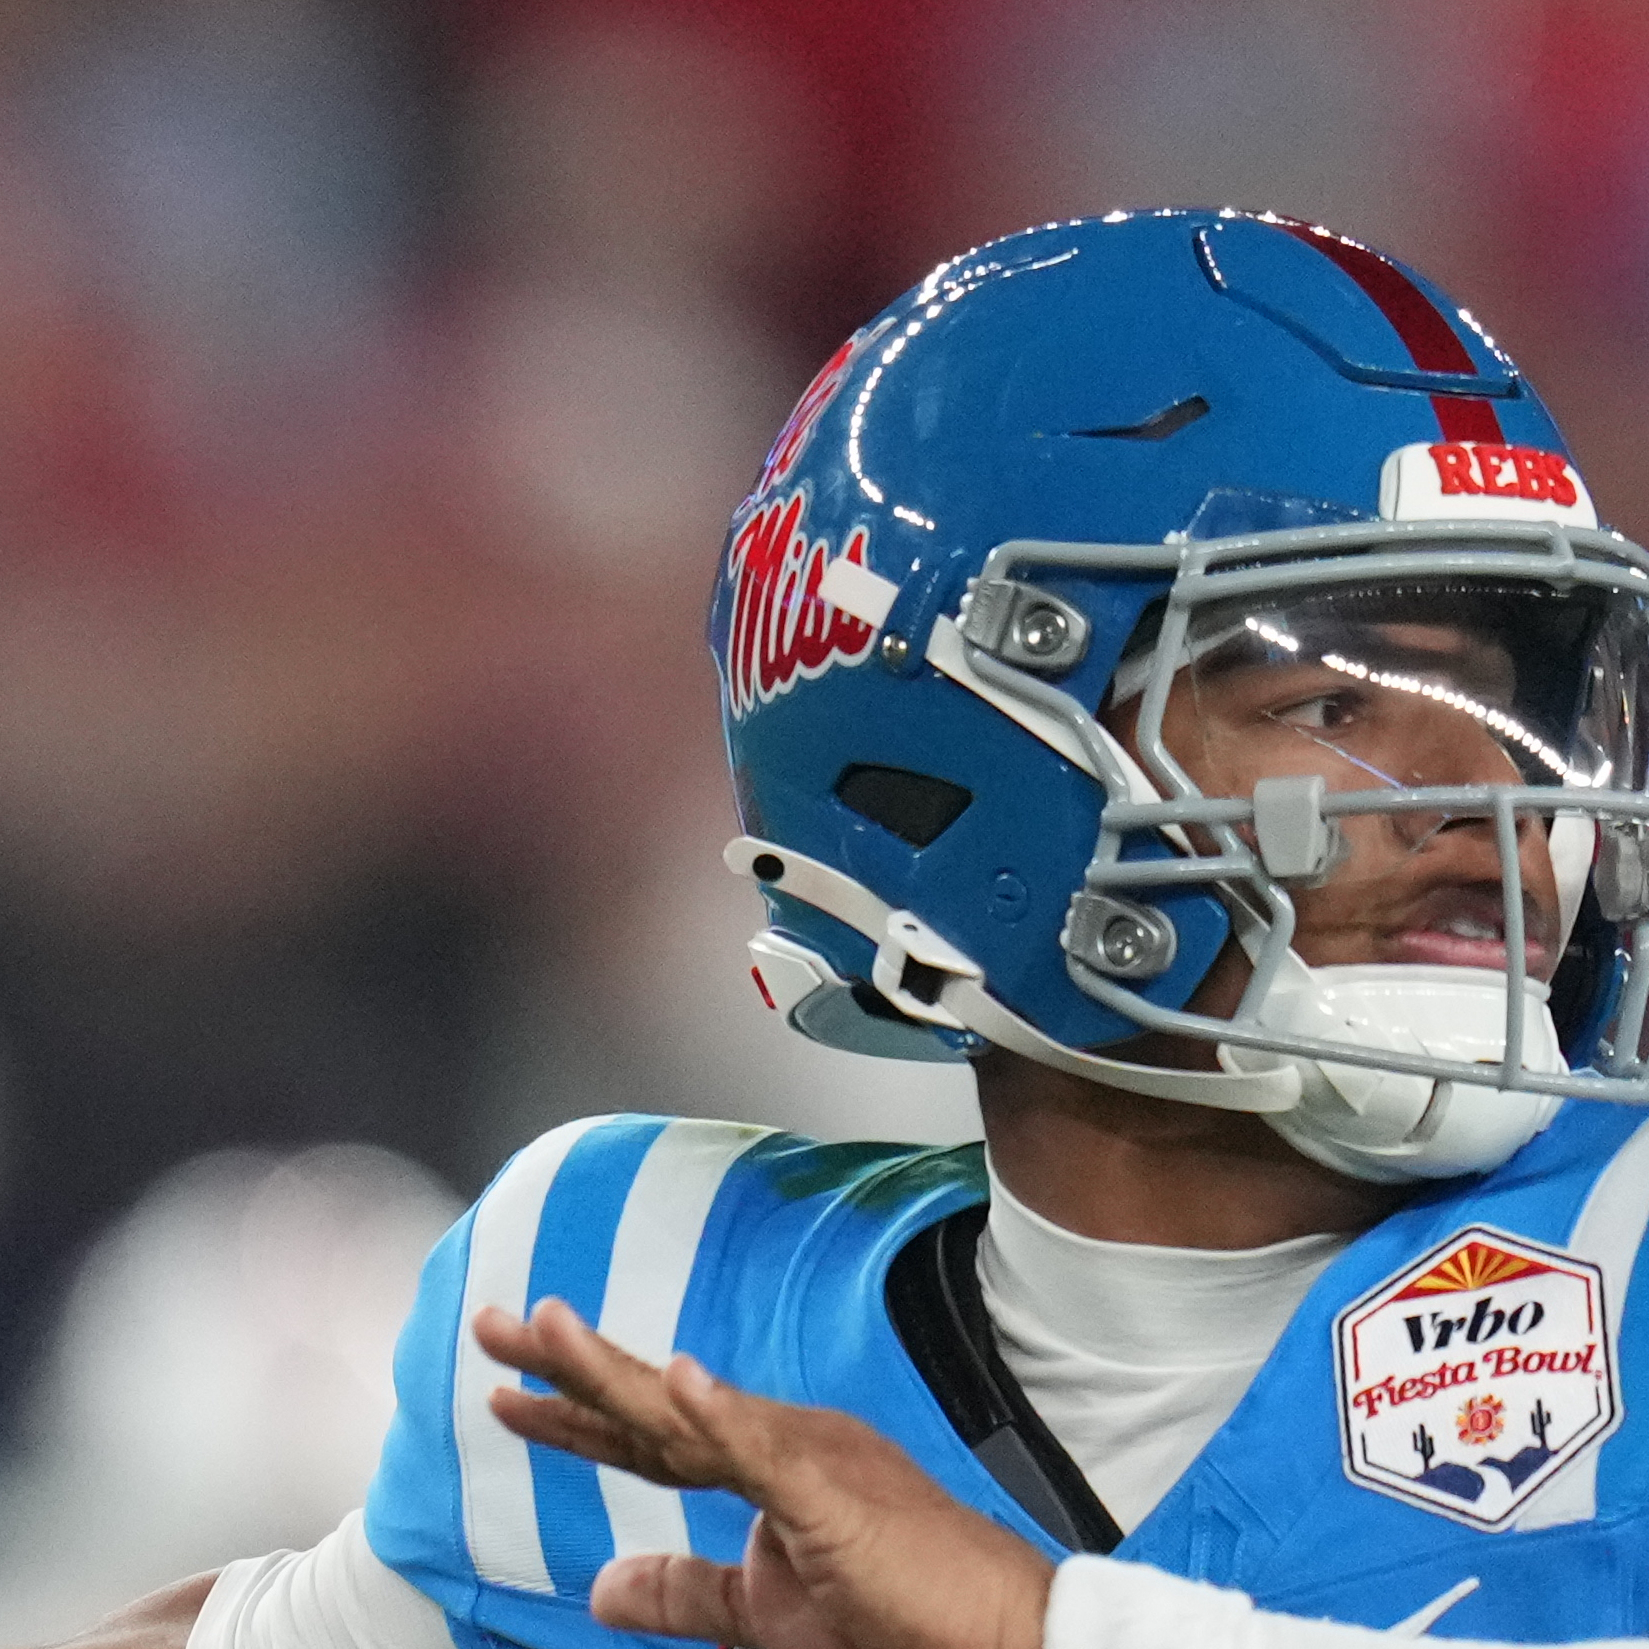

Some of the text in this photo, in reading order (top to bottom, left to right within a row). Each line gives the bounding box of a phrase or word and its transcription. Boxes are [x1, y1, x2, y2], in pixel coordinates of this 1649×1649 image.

[1428, 443, 1577, 507] REBS
[1403, 1297, 1544, 1354] Vrbo
[1353, 1344, 1597, 1419] Fiesta Bowl
